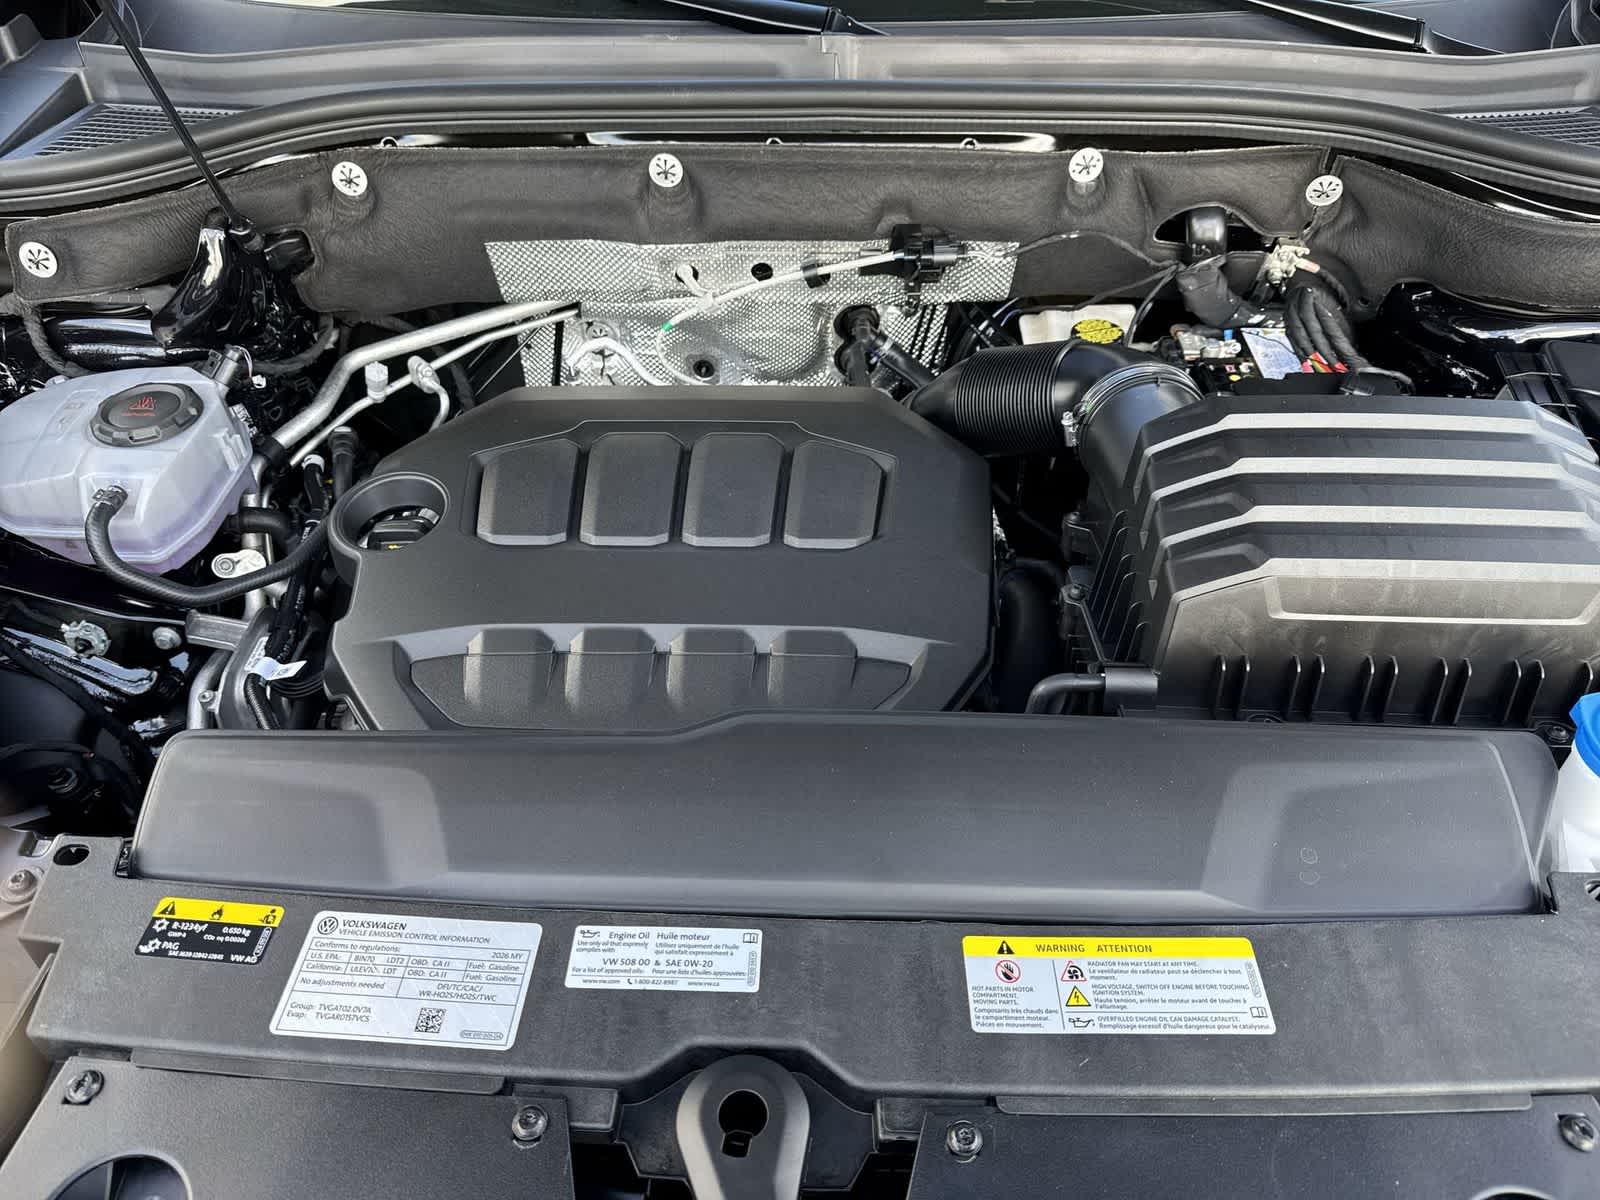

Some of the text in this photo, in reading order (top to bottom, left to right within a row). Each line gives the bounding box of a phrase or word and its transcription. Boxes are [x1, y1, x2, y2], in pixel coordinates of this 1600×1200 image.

[171, 921, 251, 937] R-1234yf 0.650 kg
[342, 919, 407, 930] VOLKSWAGEN
[339, 928, 491, 944] VEHICLE EMISSION CONTROL INFORMATION
[608, 931, 650, 941] Engine Oil
[656, 932, 711, 941] Huile moteur
[161, 941, 180, 950] PAG
[314, 940, 349, 949] Conforms
[358, 943, 401, 953] regulations:
[1035, 943, 1153, 953] WARNING ATTENTION
[230, 954, 258, 963] VW AG
[386, 956, 405, 964] LDT2
[491, 951, 524, 960] 2026 MY
[305, 962, 342, 971] California:
[410, 958, 428, 966] OBD:
[432, 959, 443, 967] CA
[468, 960, 520, 971] Fuel: Gasoline
[602, 958, 651, 966] VW 508 00
[665, 959, 714, 968] SAE 0W-20
[382, 967, 398, 975] LDT
[407, 968, 425, 977] OBD:
[428, 970, 440, 978] CA
[465, 972, 517, 982] Fuel: Gasoline
[300, 977, 386, 989] No adjustments needed
[290, 1001, 315, 1010] Group:
[286, 1009, 306, 1018] Evap:
